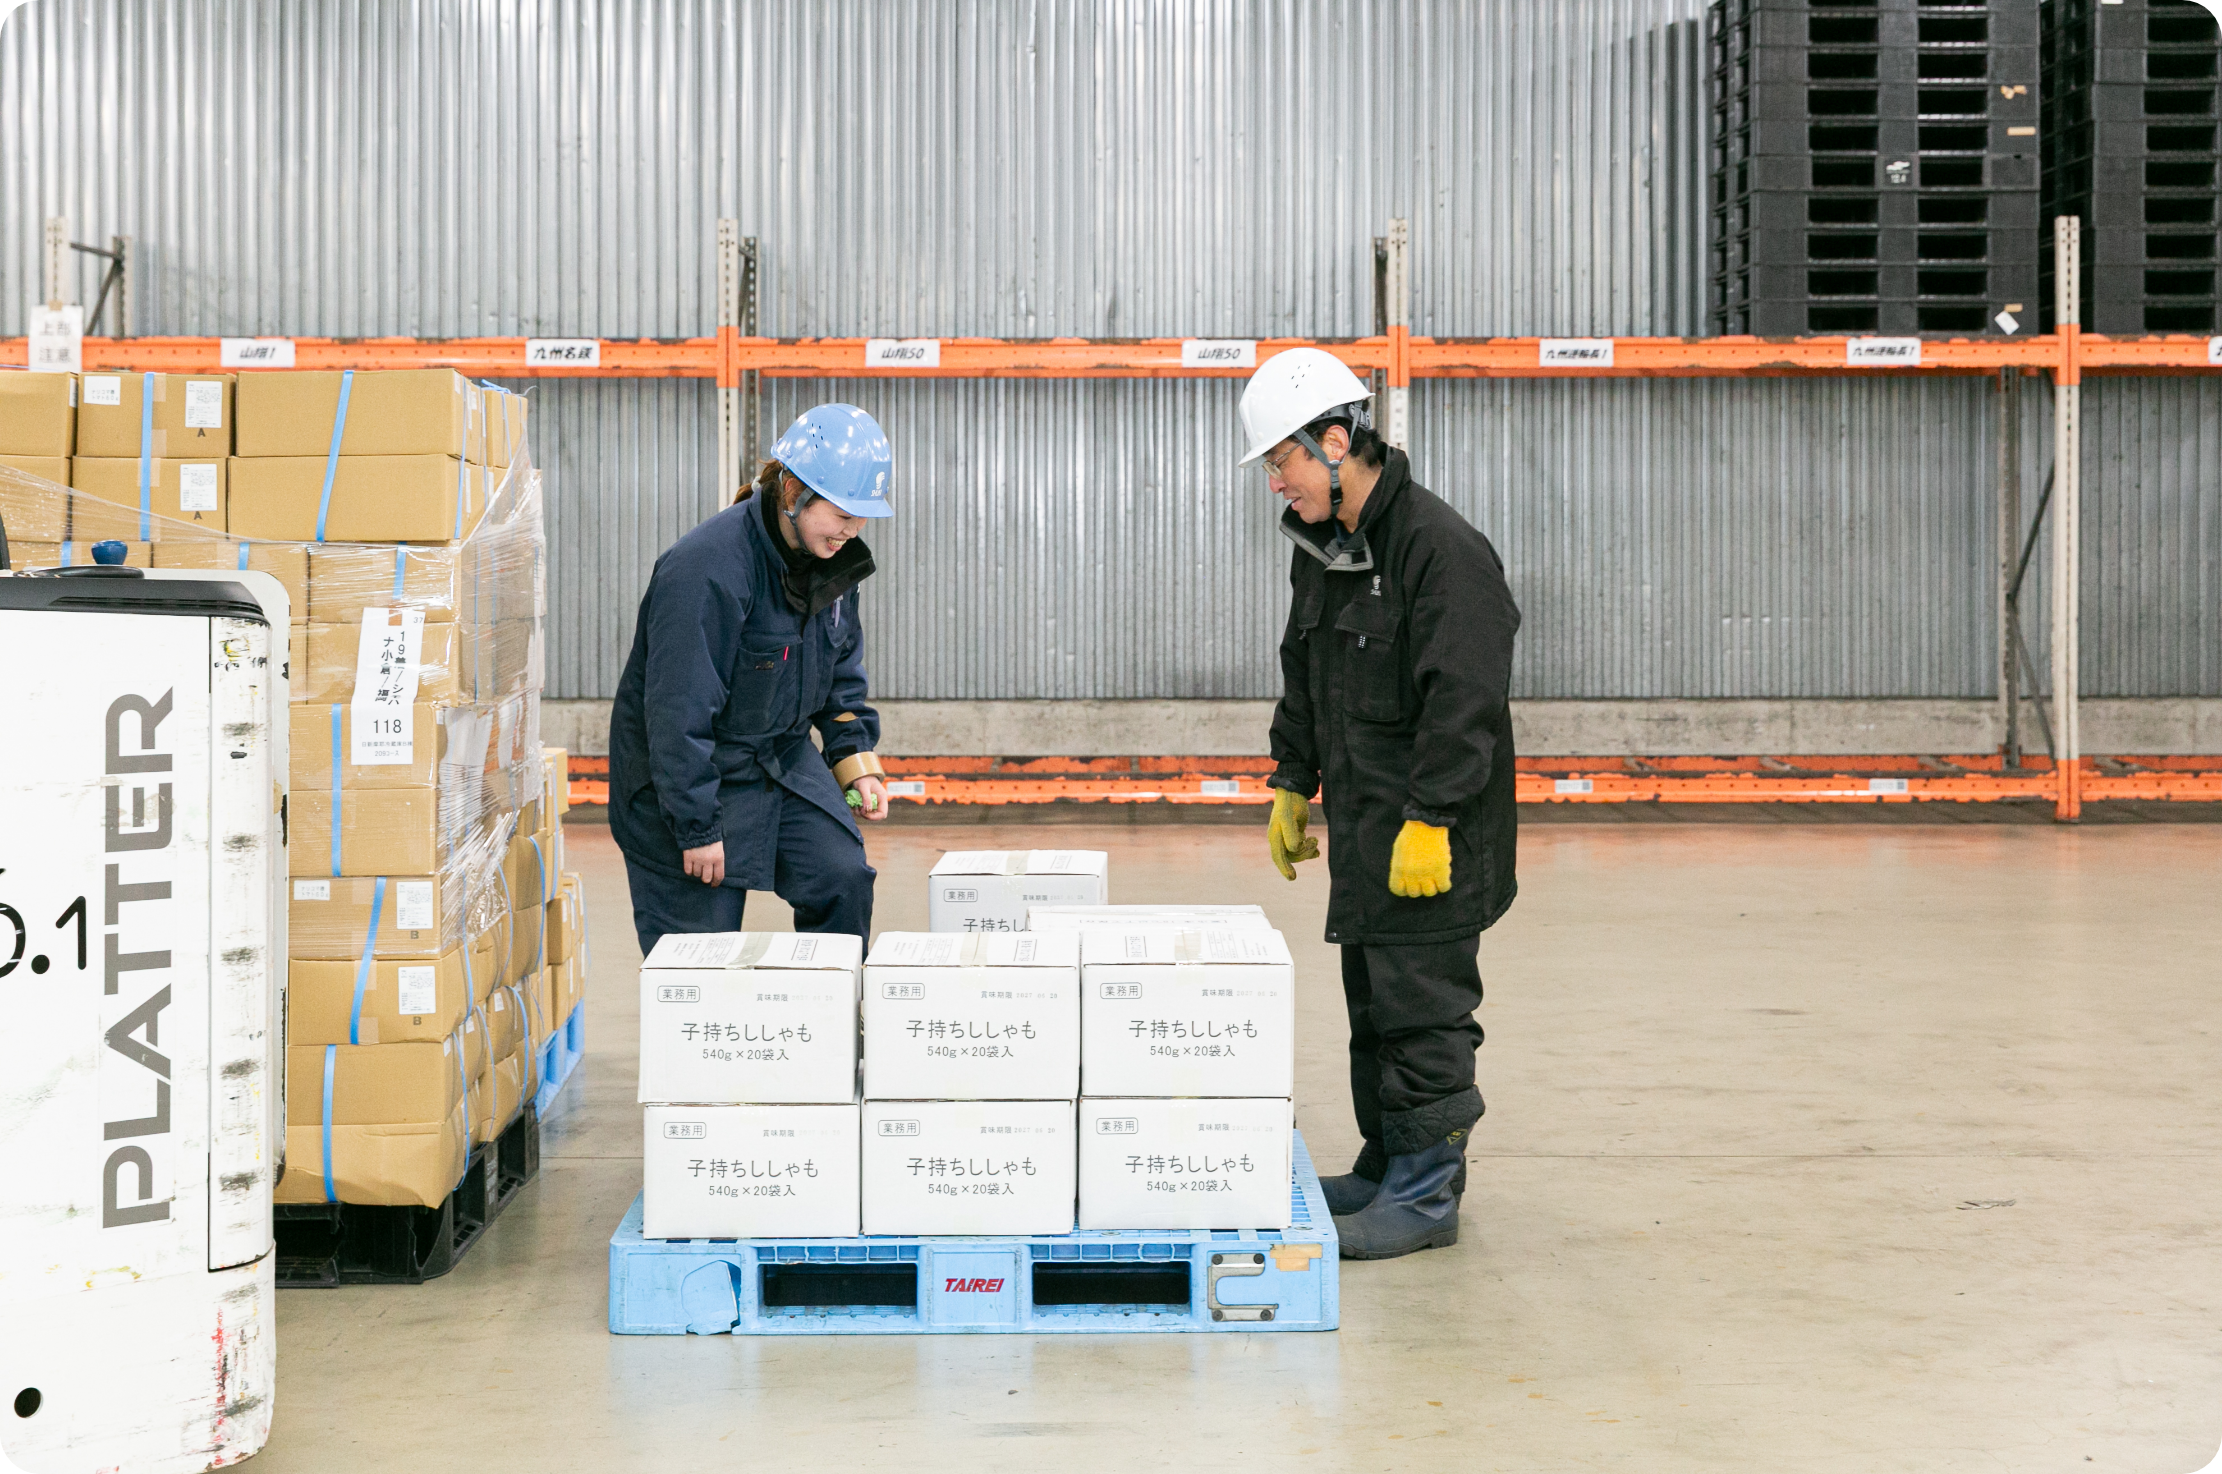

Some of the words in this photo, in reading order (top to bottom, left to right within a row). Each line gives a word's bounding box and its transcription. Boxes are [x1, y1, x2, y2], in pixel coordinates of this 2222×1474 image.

[197, 427, 206, 438] A
[193, 510, 202, 520] A
[373, 719, 402, 734] 118
[948, 891, 975, 900] 業務用
[1022, 894, 1048, 902] 賞味期限
[410, 930, 420, 940] B
[103, 686, 173, 1228] PLATTER
[662, 988, 697, 1000] 業務用
[887, 985, 921, 997] 業務用
[980, 990, 1013, 999] 賞味期限
[1105, 985, 1139, 997] 業務用
[1201, 988, 1234, 997] 賞味期限
[756, 993, 789, 1002] 賞味期限
[413, 1015, 423, 1026] B
[681, 1021, 812, 1043] 子持ちししゃも
[906, 1019, 1036, 1039] 子持ちししゃも
[1128, 1019, 1258, 1039] 子持ちししゃも
[668, 1125, 703, 1137] 業務用
[883, 1123, 917, 1134] 業務用
[980, 1126, 1012, 1134] 賞味期限
[1101, 1121, 1135, 1132] 業務用
[1198, 1123, 1230, 1132] 賞味期限
[762, 1129, 795, 1138] 賞味期限
[687, 1158, 819, 1179] 子持ちししゃも
[906, 1156, 1037, 1177] 子持ちししゃも
[1125, 1154, 1255, 1174] 子持ちししゃも
[944, 1278, 1006, 1293] TAIREI
